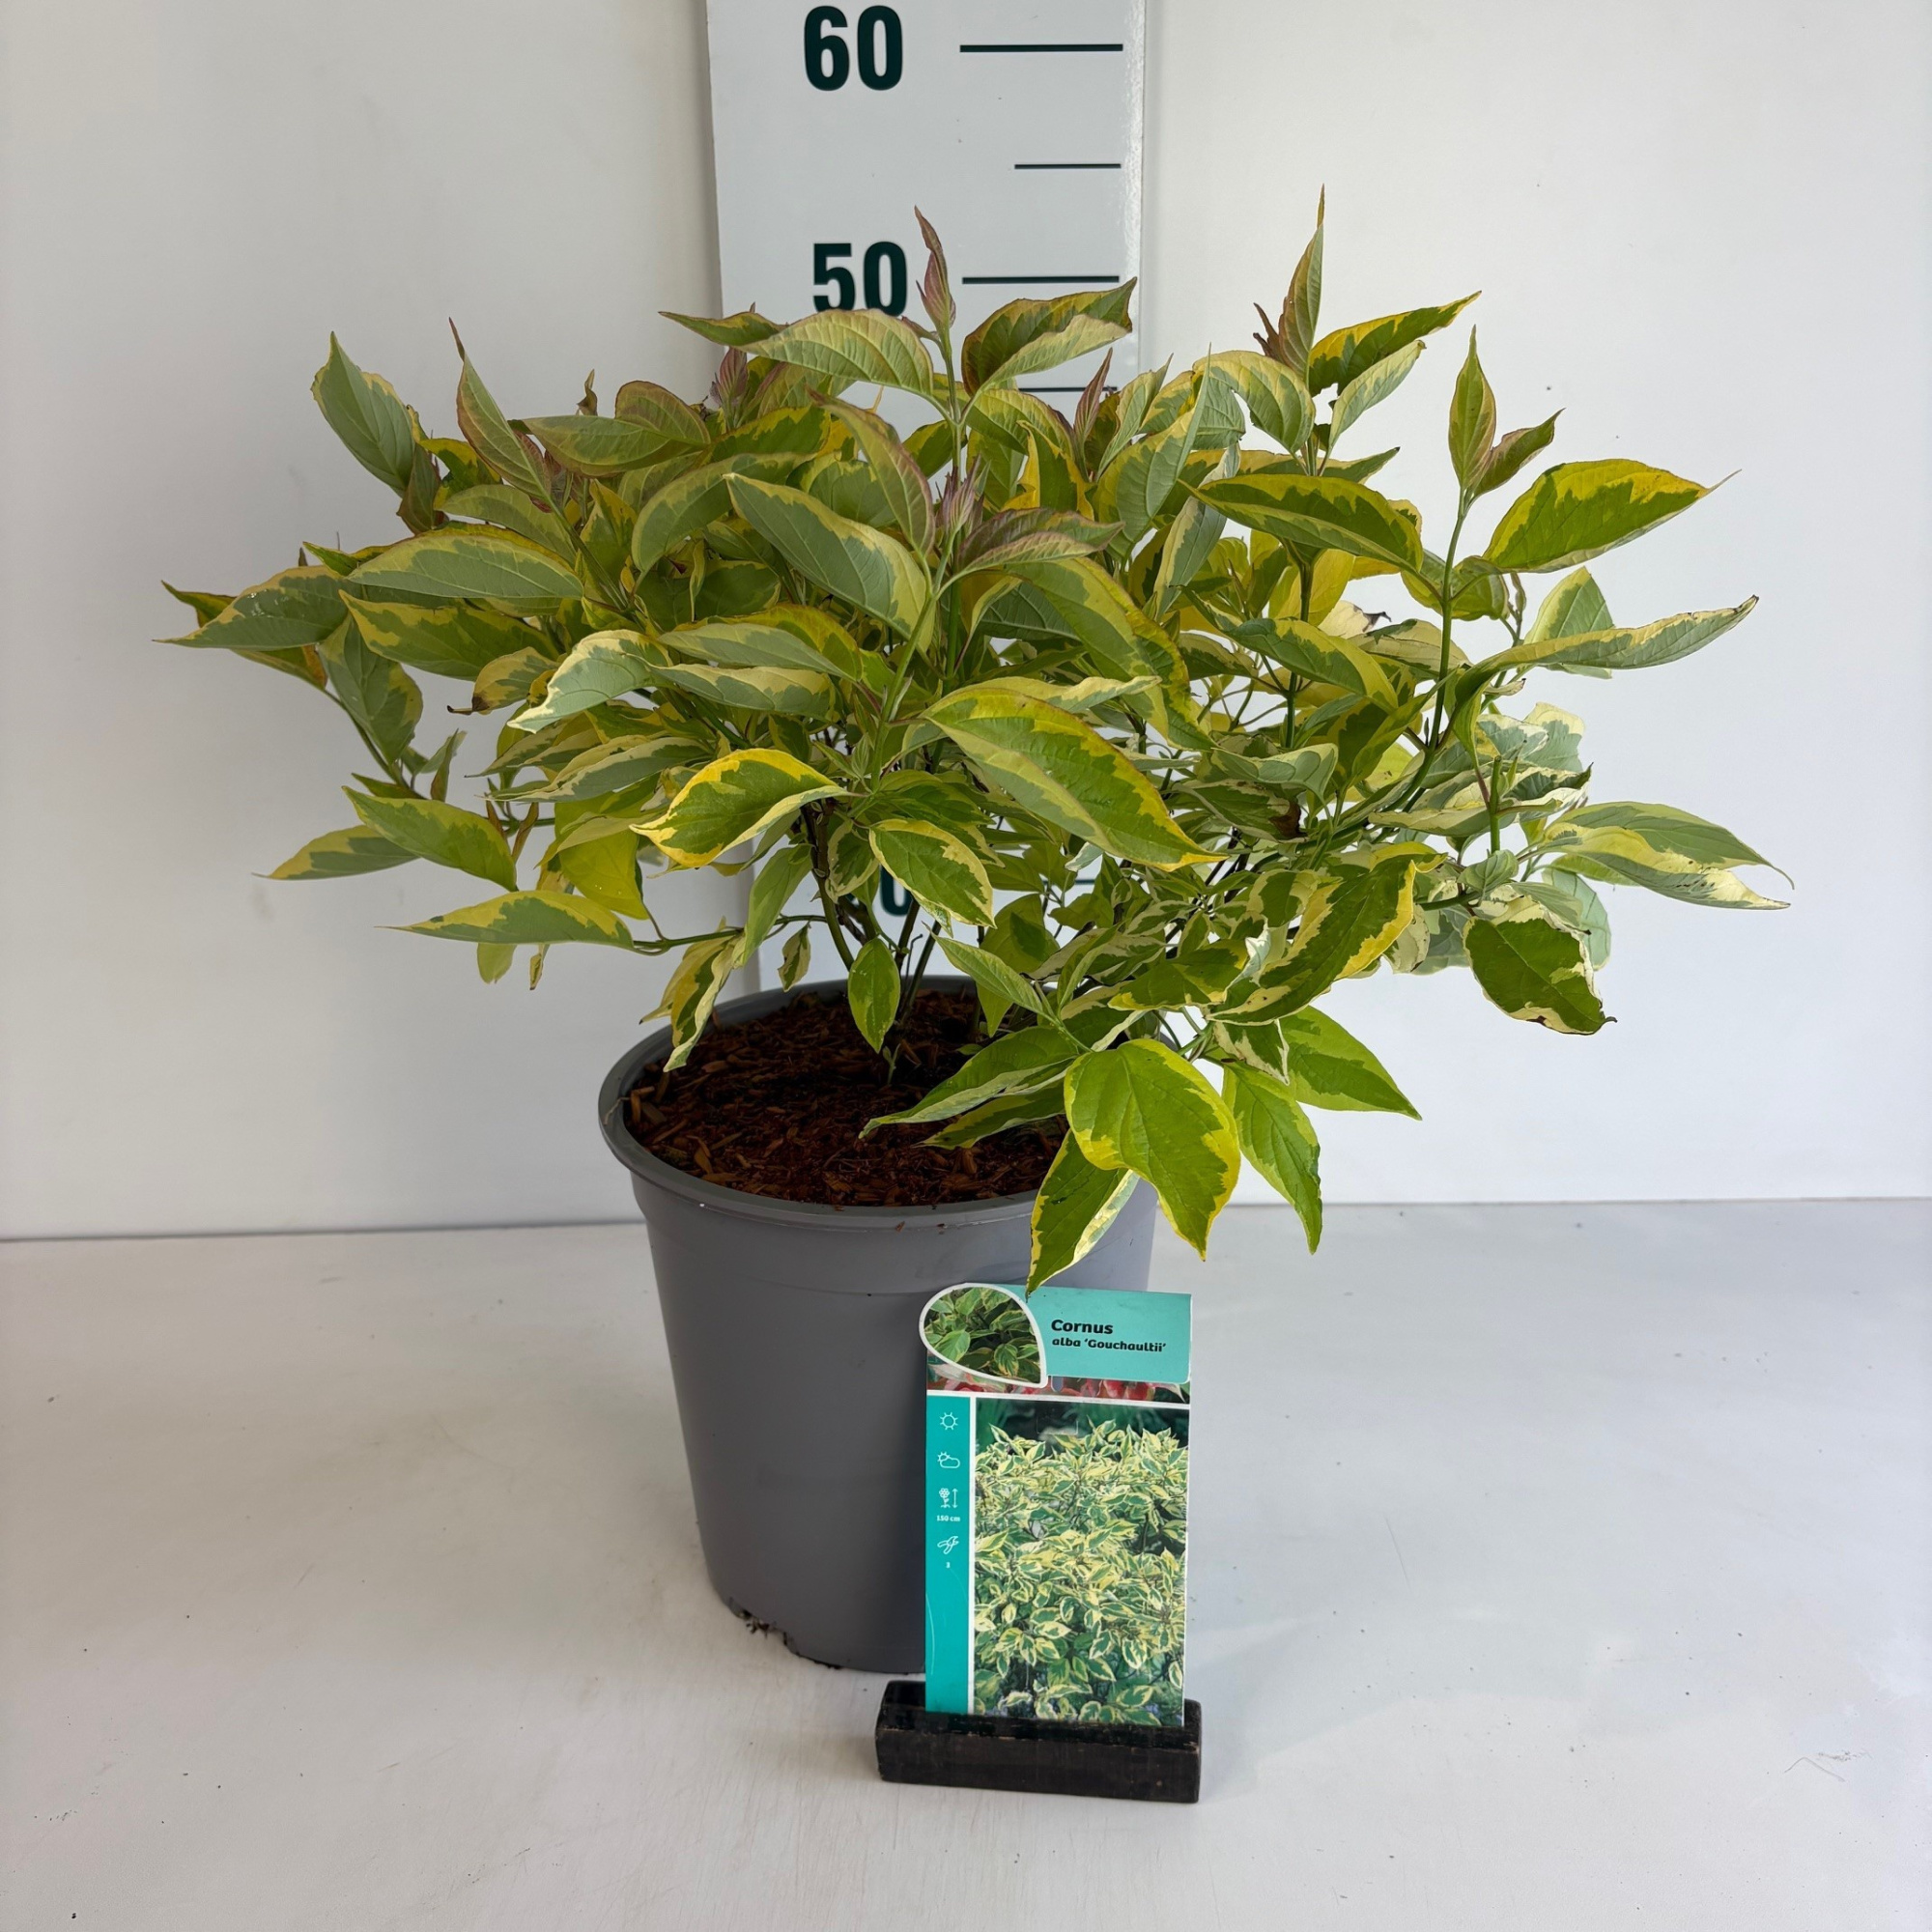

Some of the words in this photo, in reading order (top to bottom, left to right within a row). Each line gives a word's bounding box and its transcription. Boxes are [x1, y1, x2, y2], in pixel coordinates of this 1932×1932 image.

[804, 5, 903, 92] 60
[812, 242, 908, 317] 50
[1051, 1319, 1114, 1335] Cornus
[1052, 1337, 1082, 1348] alba
